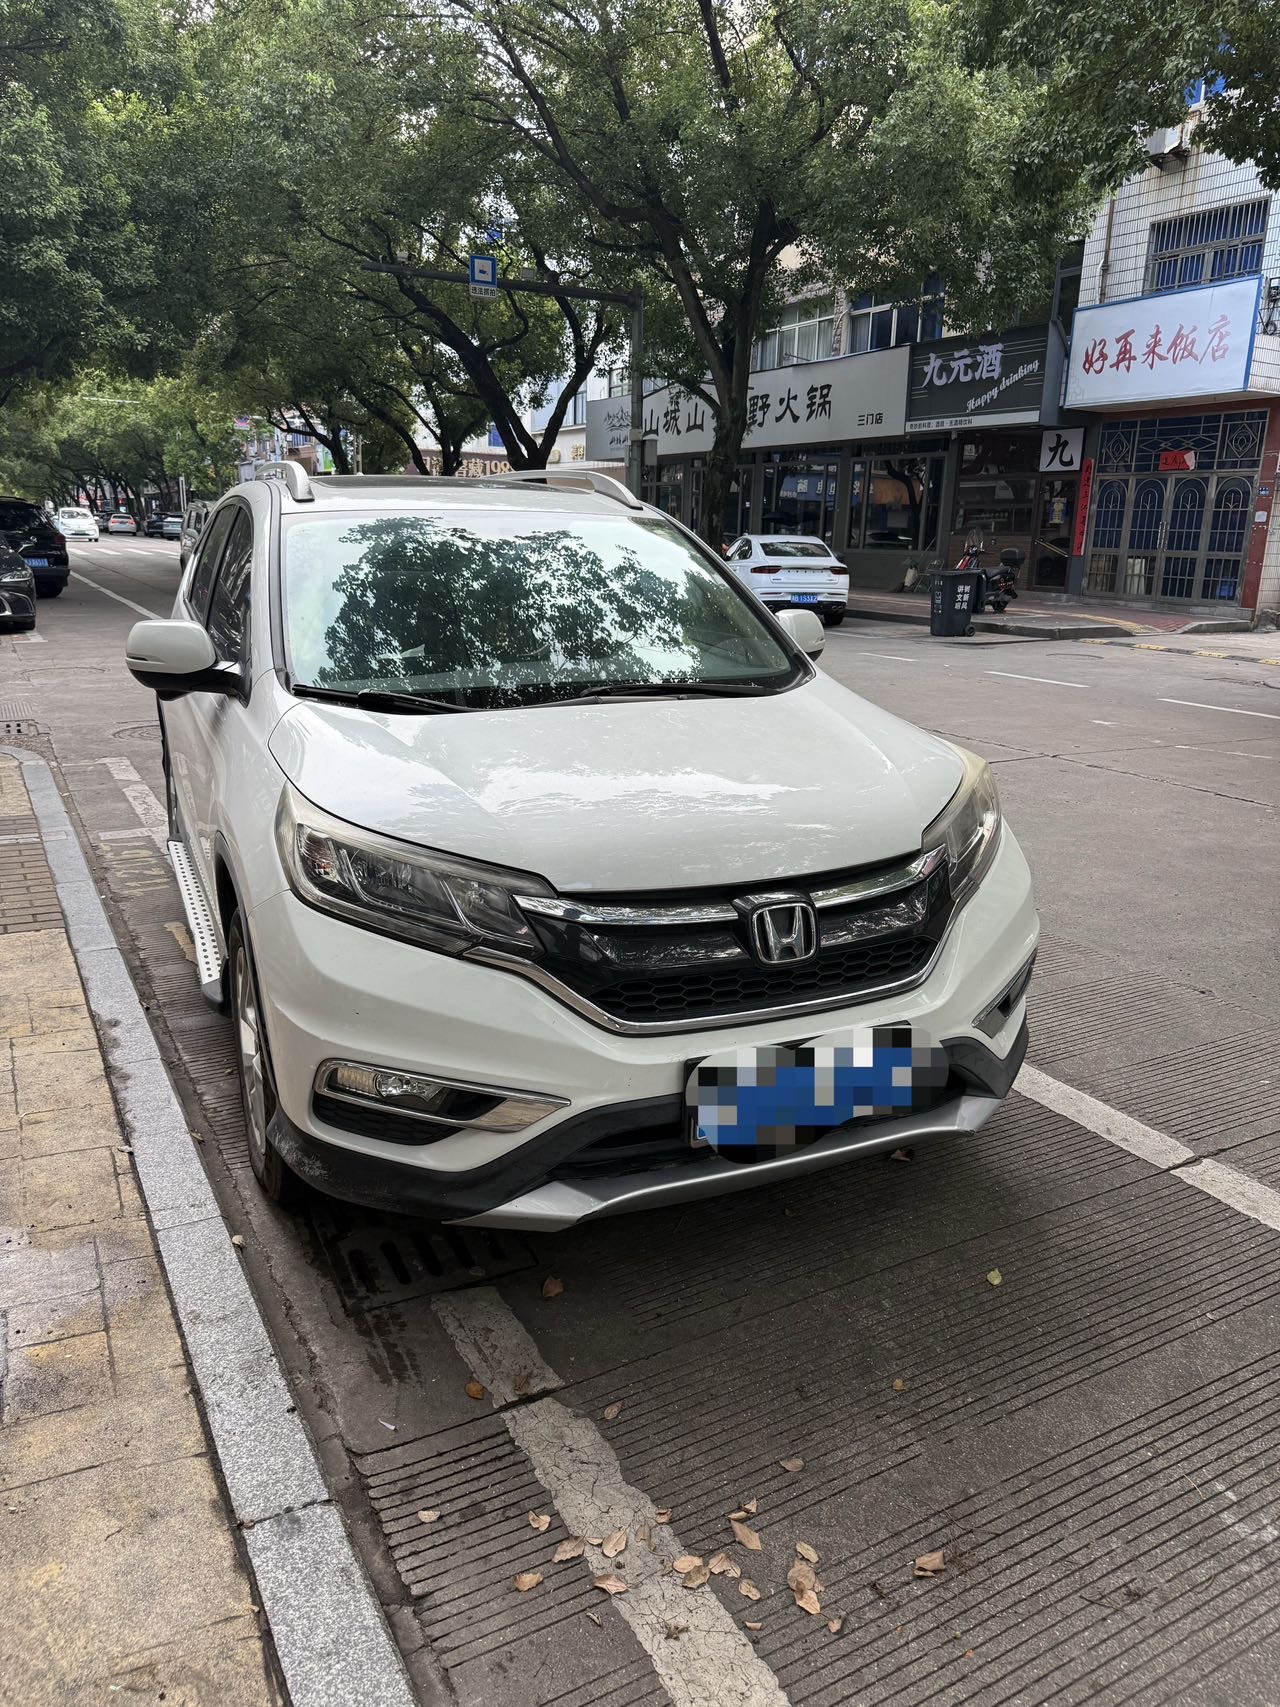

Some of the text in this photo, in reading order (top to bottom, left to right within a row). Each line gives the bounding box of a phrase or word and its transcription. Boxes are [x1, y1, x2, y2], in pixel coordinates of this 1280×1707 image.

[471, 286, 496, 297] 违法抓拍
[1082, 314, 1231, 375] 好再来饭店
[921, 342, 1004, 388] 九元酒
[966, 359, 1040, 413] Happy drinking
[857, 412, 884, 426] 三门店
[1046, 433, 1074, 468] 九
